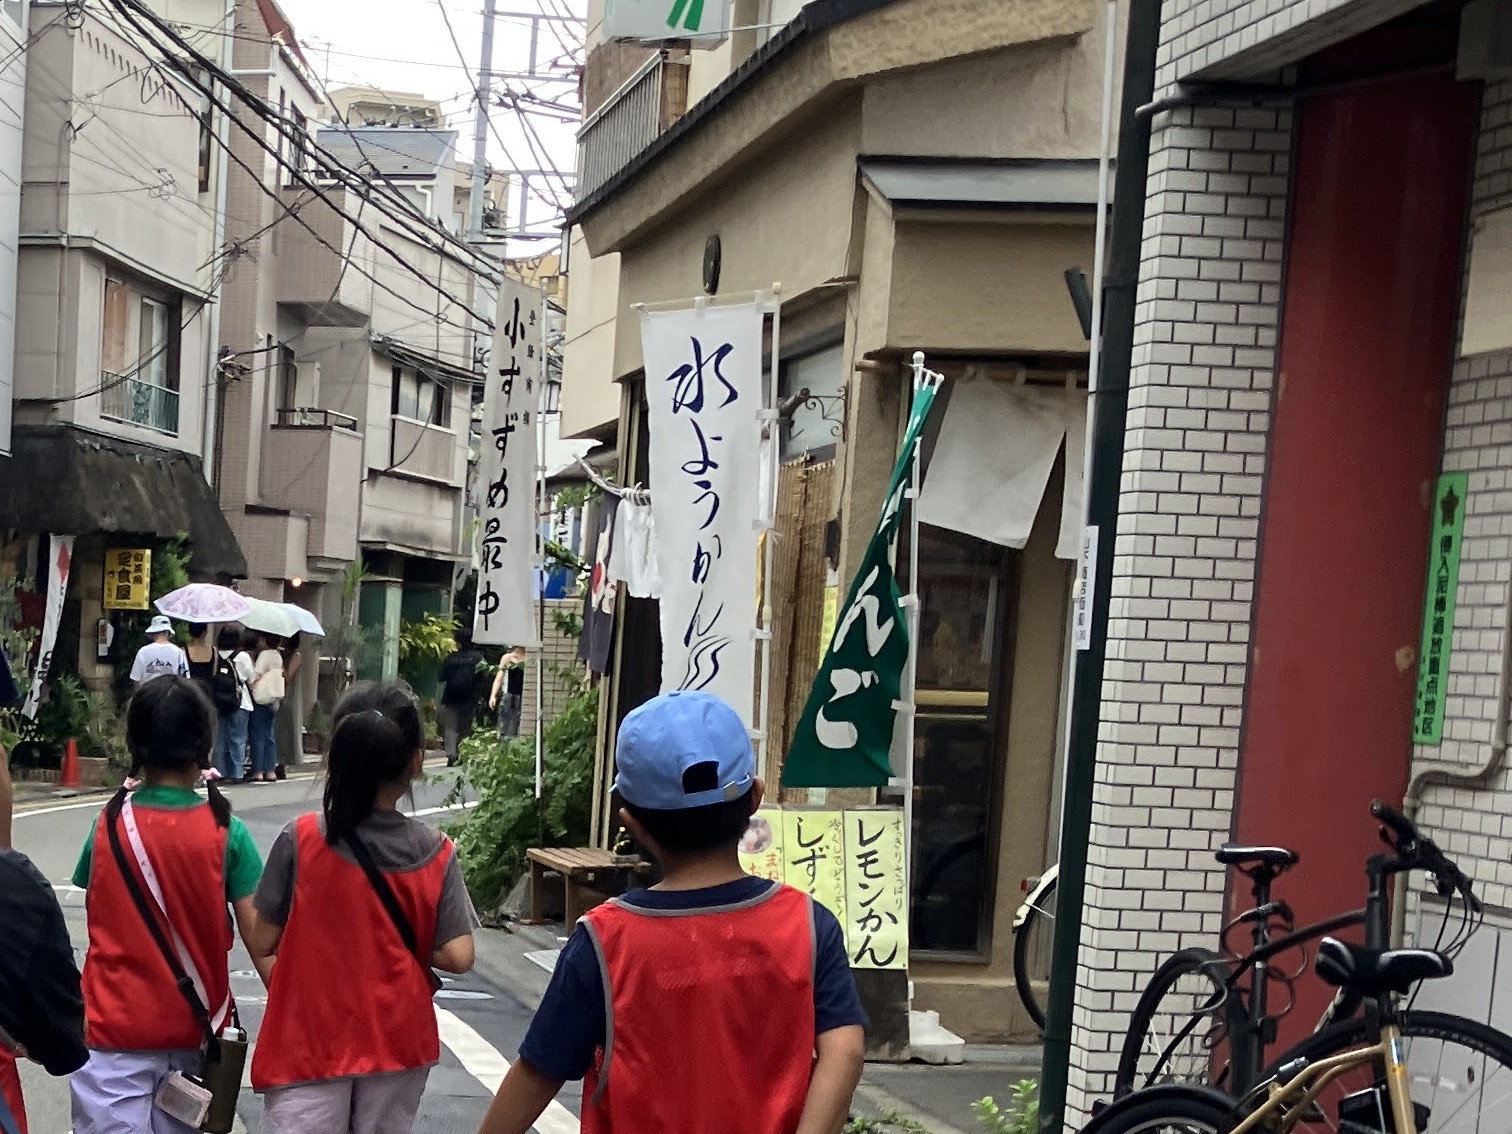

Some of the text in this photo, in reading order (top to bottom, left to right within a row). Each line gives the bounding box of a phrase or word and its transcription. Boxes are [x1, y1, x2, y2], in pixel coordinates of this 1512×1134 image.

[478, 296, 525, 632] 小すずめ最中
[666, 336, 739, 648] 水ようかん
[853, 818, 899, 967] レモンかん
